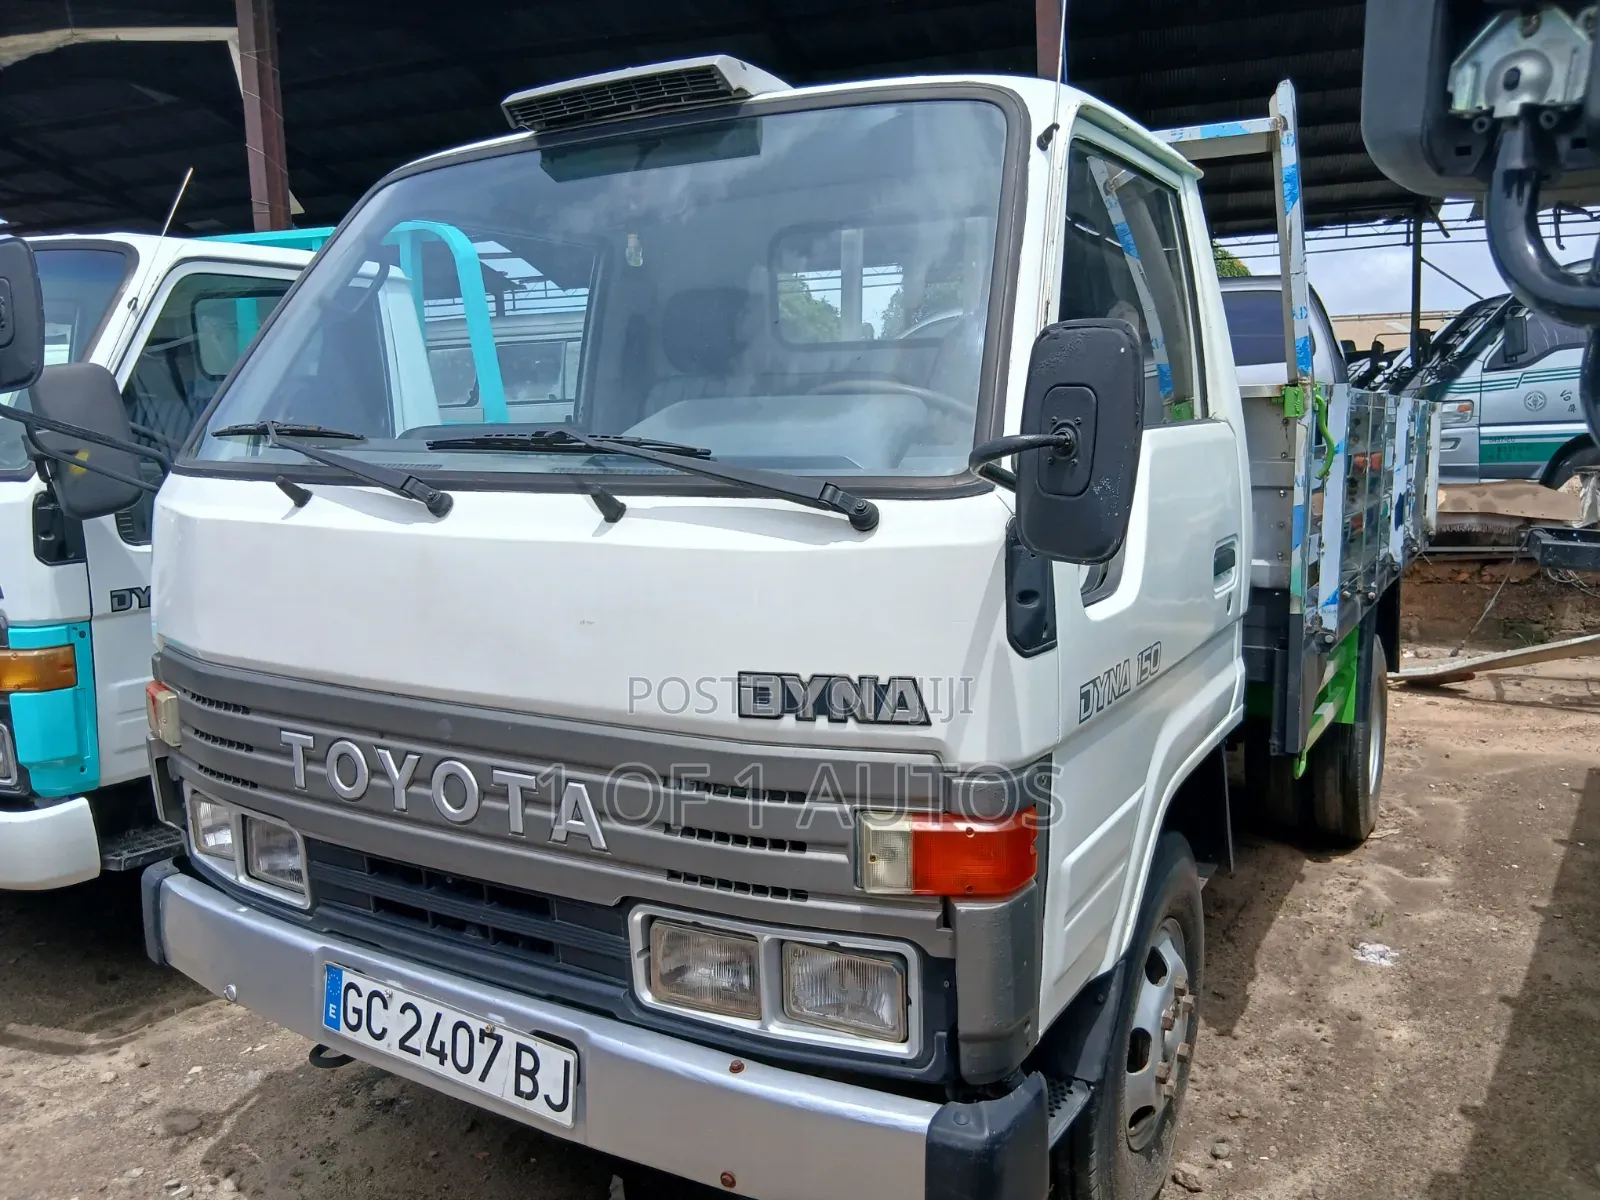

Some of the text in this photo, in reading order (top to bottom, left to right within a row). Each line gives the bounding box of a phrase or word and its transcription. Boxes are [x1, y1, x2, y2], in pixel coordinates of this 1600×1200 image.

[738, 671, 932, 726] DYNA
[1079, 641, 1161, 724] DYNA 150
[280, 729, 610, 853] TOYOTA
[329, 1004, 337, 1020] E
[343, 981, 571, 1113] GC 2407 BJ
